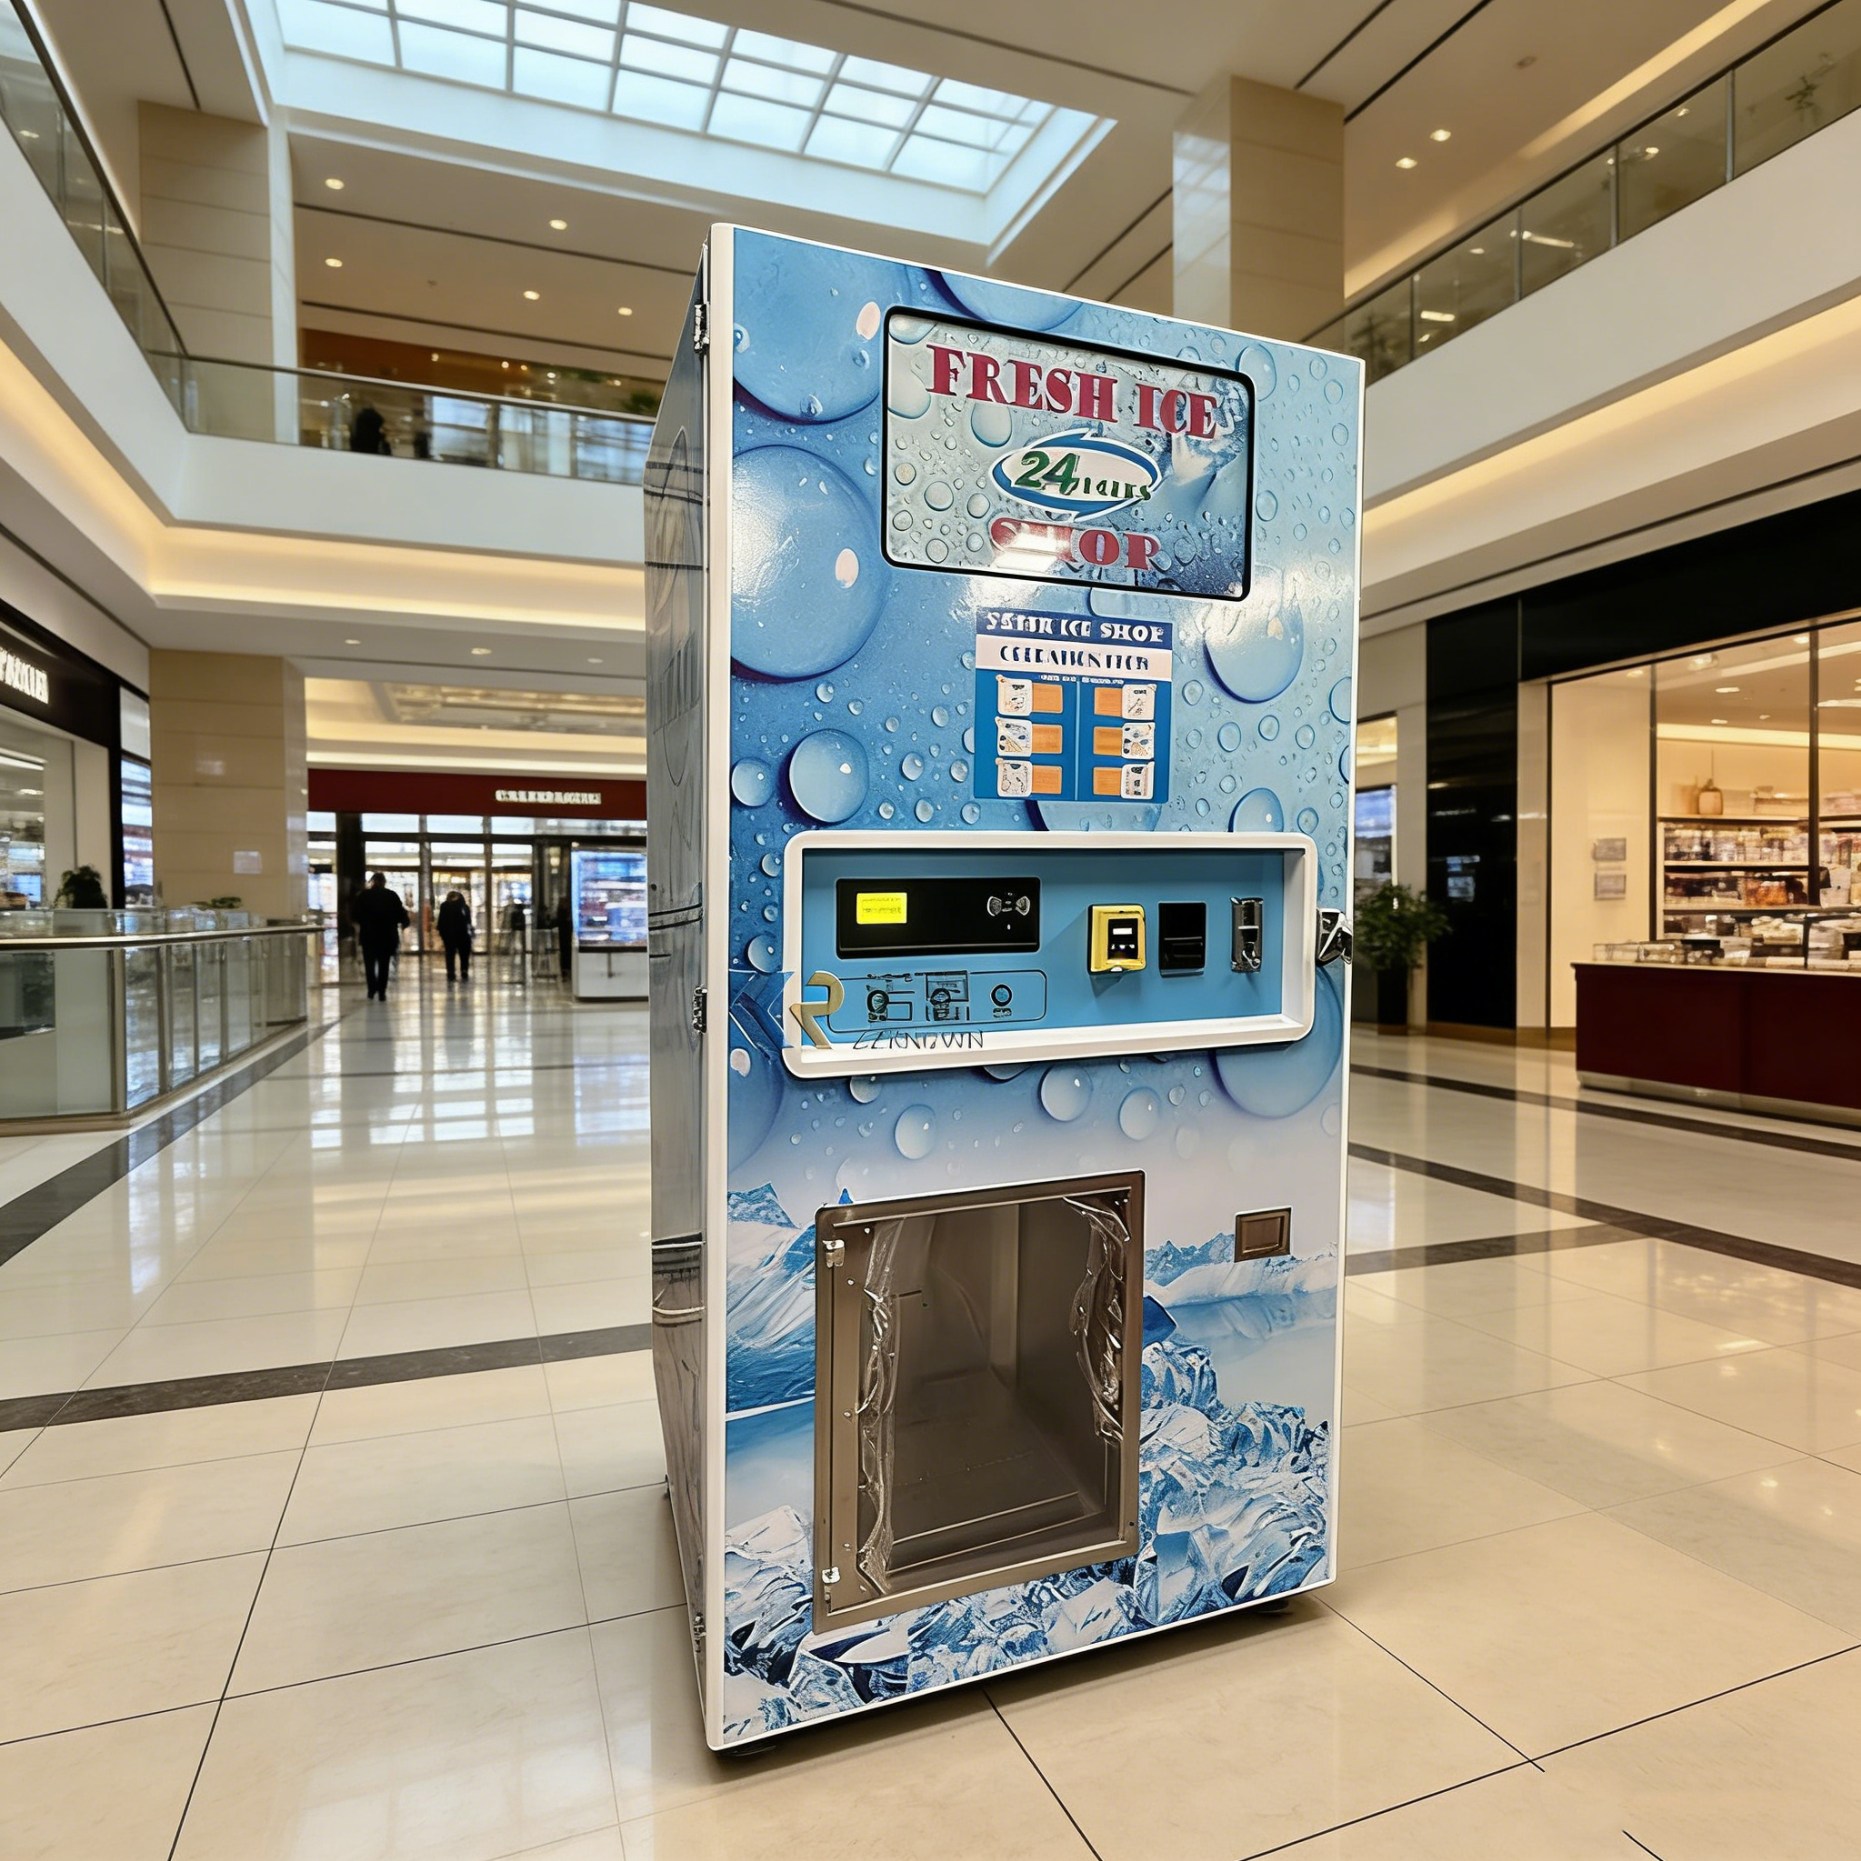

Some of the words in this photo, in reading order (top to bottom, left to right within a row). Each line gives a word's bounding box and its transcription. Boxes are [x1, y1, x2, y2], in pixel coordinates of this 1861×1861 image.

[926, 344, 1118, 424] FRESH
[1133, 383, 1218, 440] ICE
[1014, 450, 1080, 496] 24
[1099, 623, 1165, 643] SHOP
